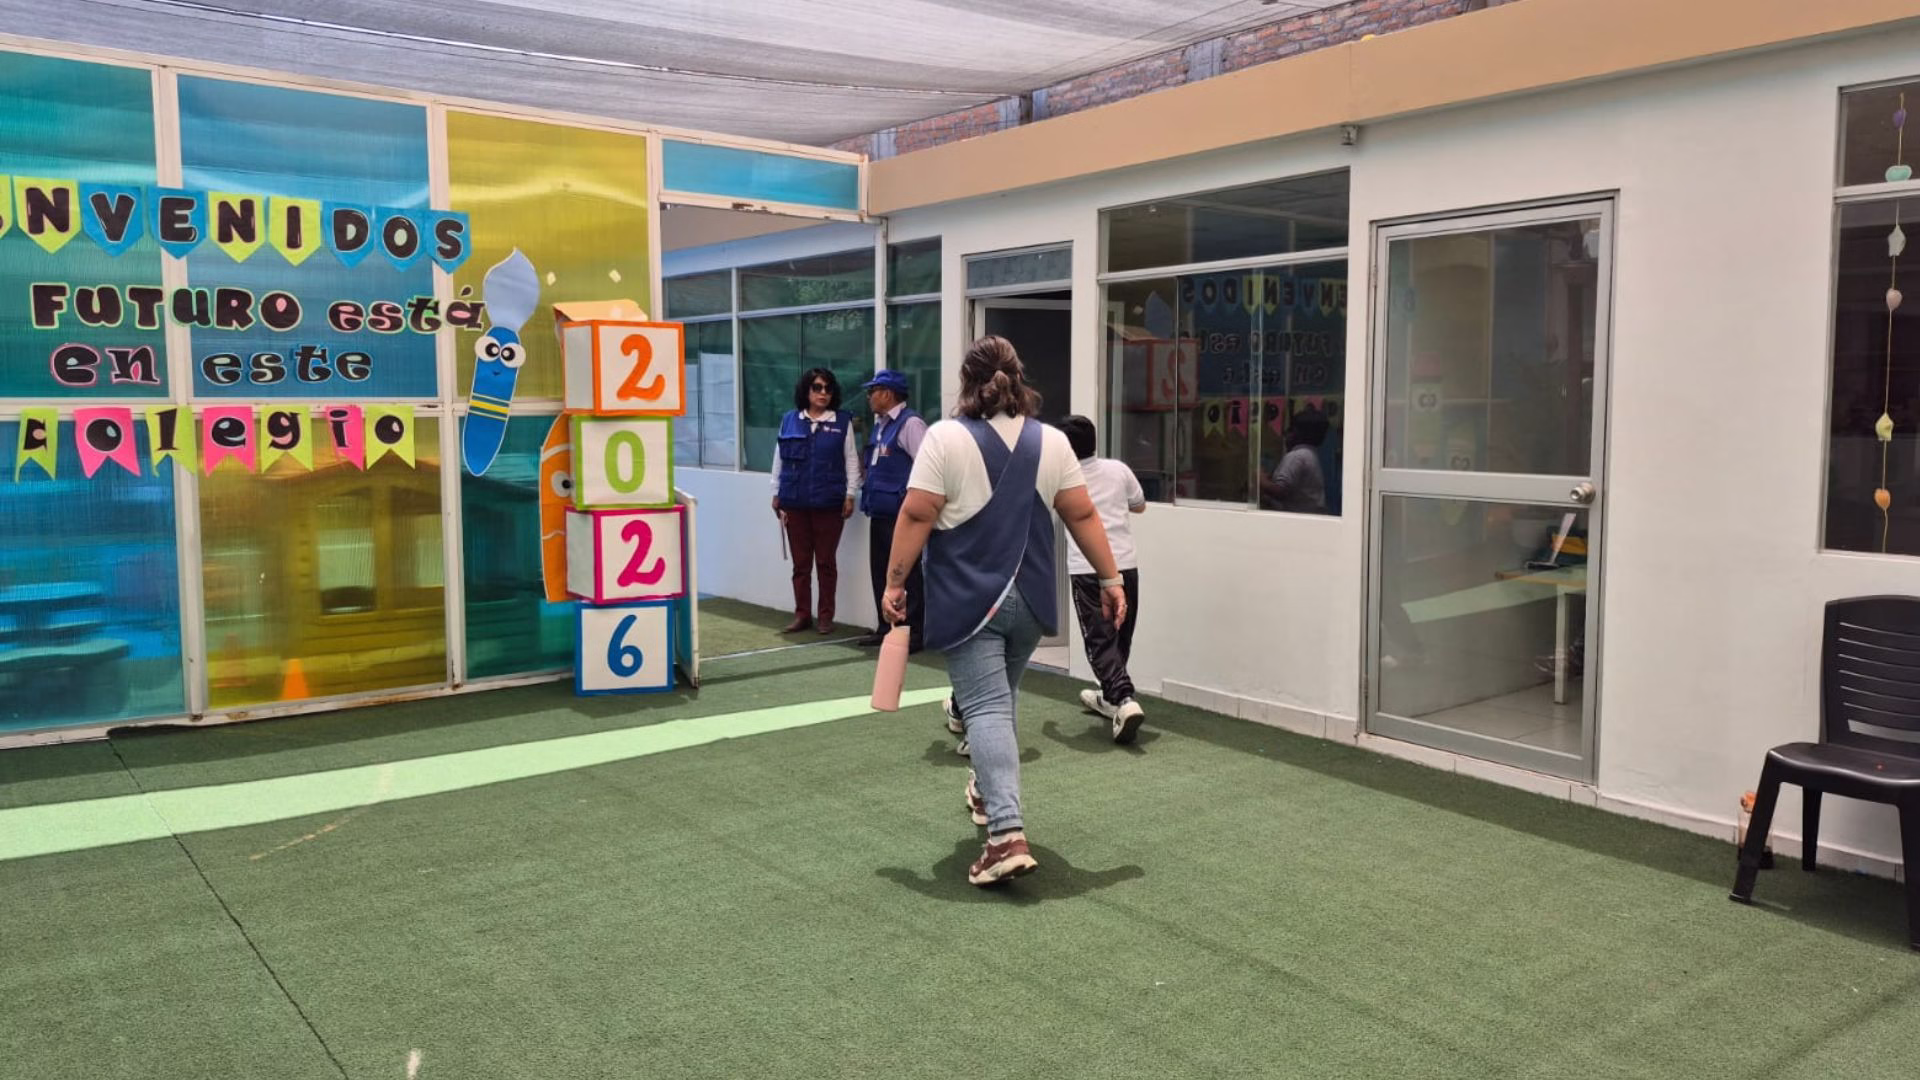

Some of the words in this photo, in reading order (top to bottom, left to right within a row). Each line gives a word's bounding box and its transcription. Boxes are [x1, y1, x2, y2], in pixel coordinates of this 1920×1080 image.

[0, 186, 465, 261] NVENIDOS
[328, 284, 486, 333] está
[51, 343, 161, 386] en
[201, 344, 373, 385] este
[23, 407, 405, 454] colegio
